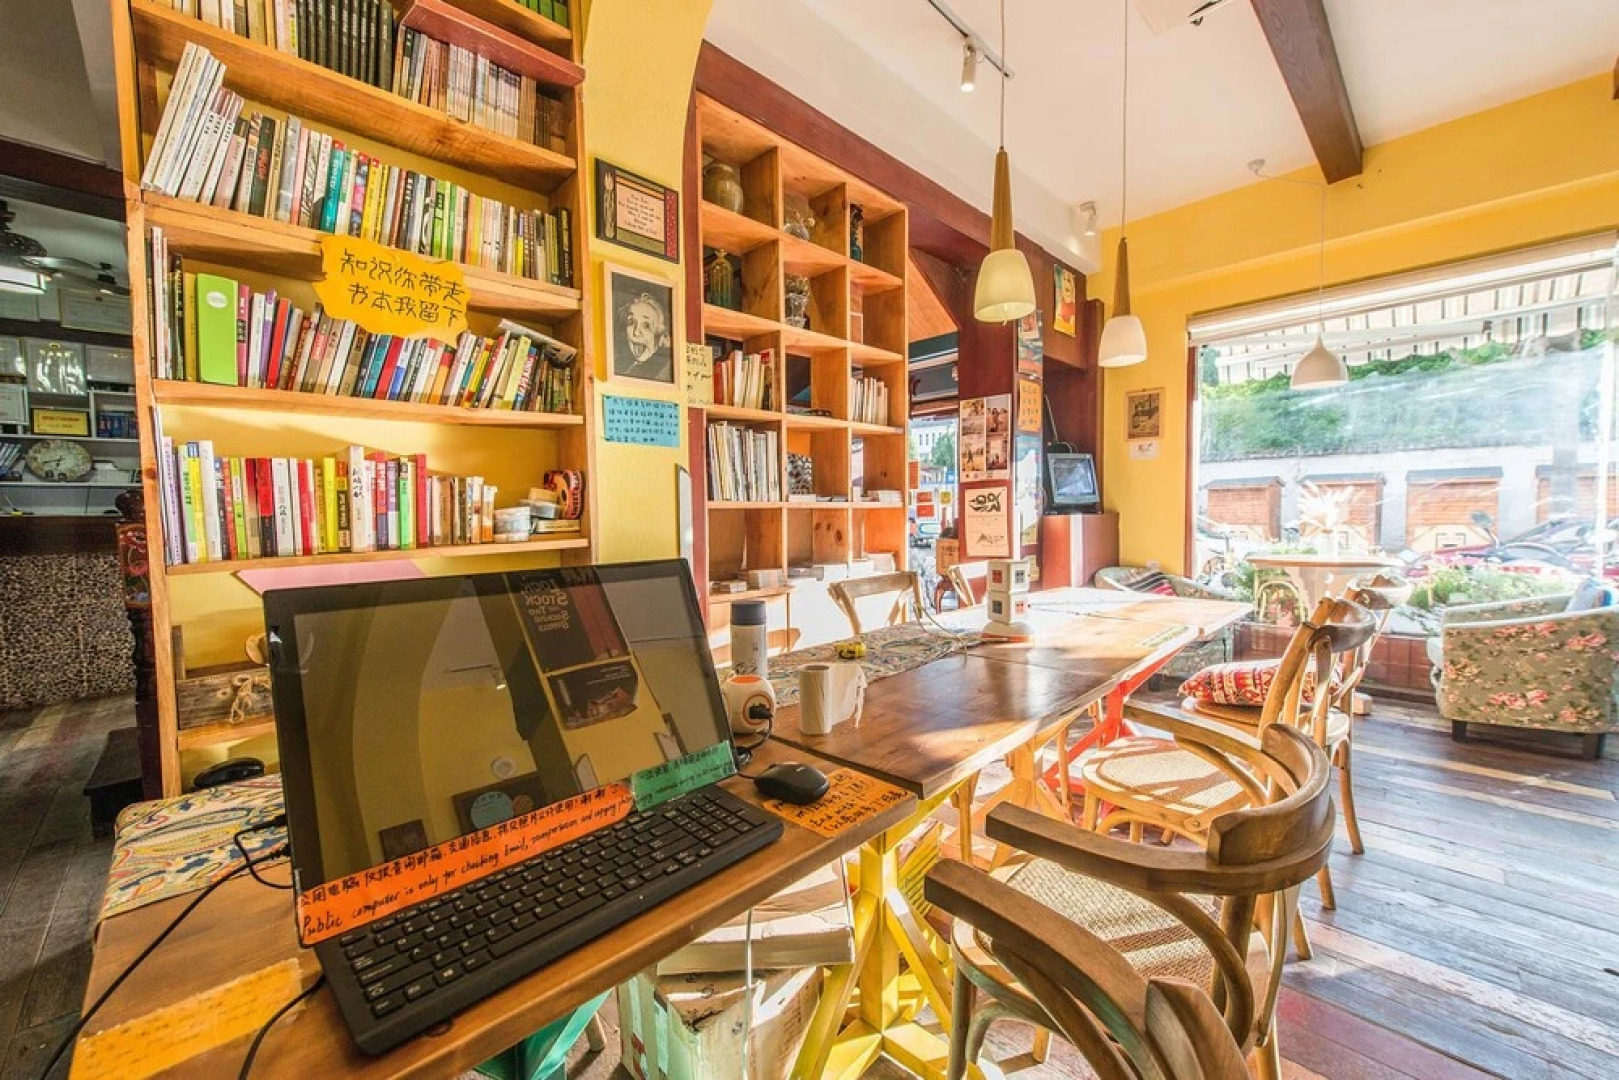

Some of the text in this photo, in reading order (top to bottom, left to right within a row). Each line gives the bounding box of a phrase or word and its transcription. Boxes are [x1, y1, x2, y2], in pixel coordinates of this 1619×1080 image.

[340, 248, 465, 304] 知识你带走
[348, 282, 463, 327] 书本我留下
[303, 910, 342, 936] Public
[352, 891, 401, 916] computer
[418, 873, 439, 893] only
[442, 868, 457, 886] for
[461, 852, 499, 874] checking
